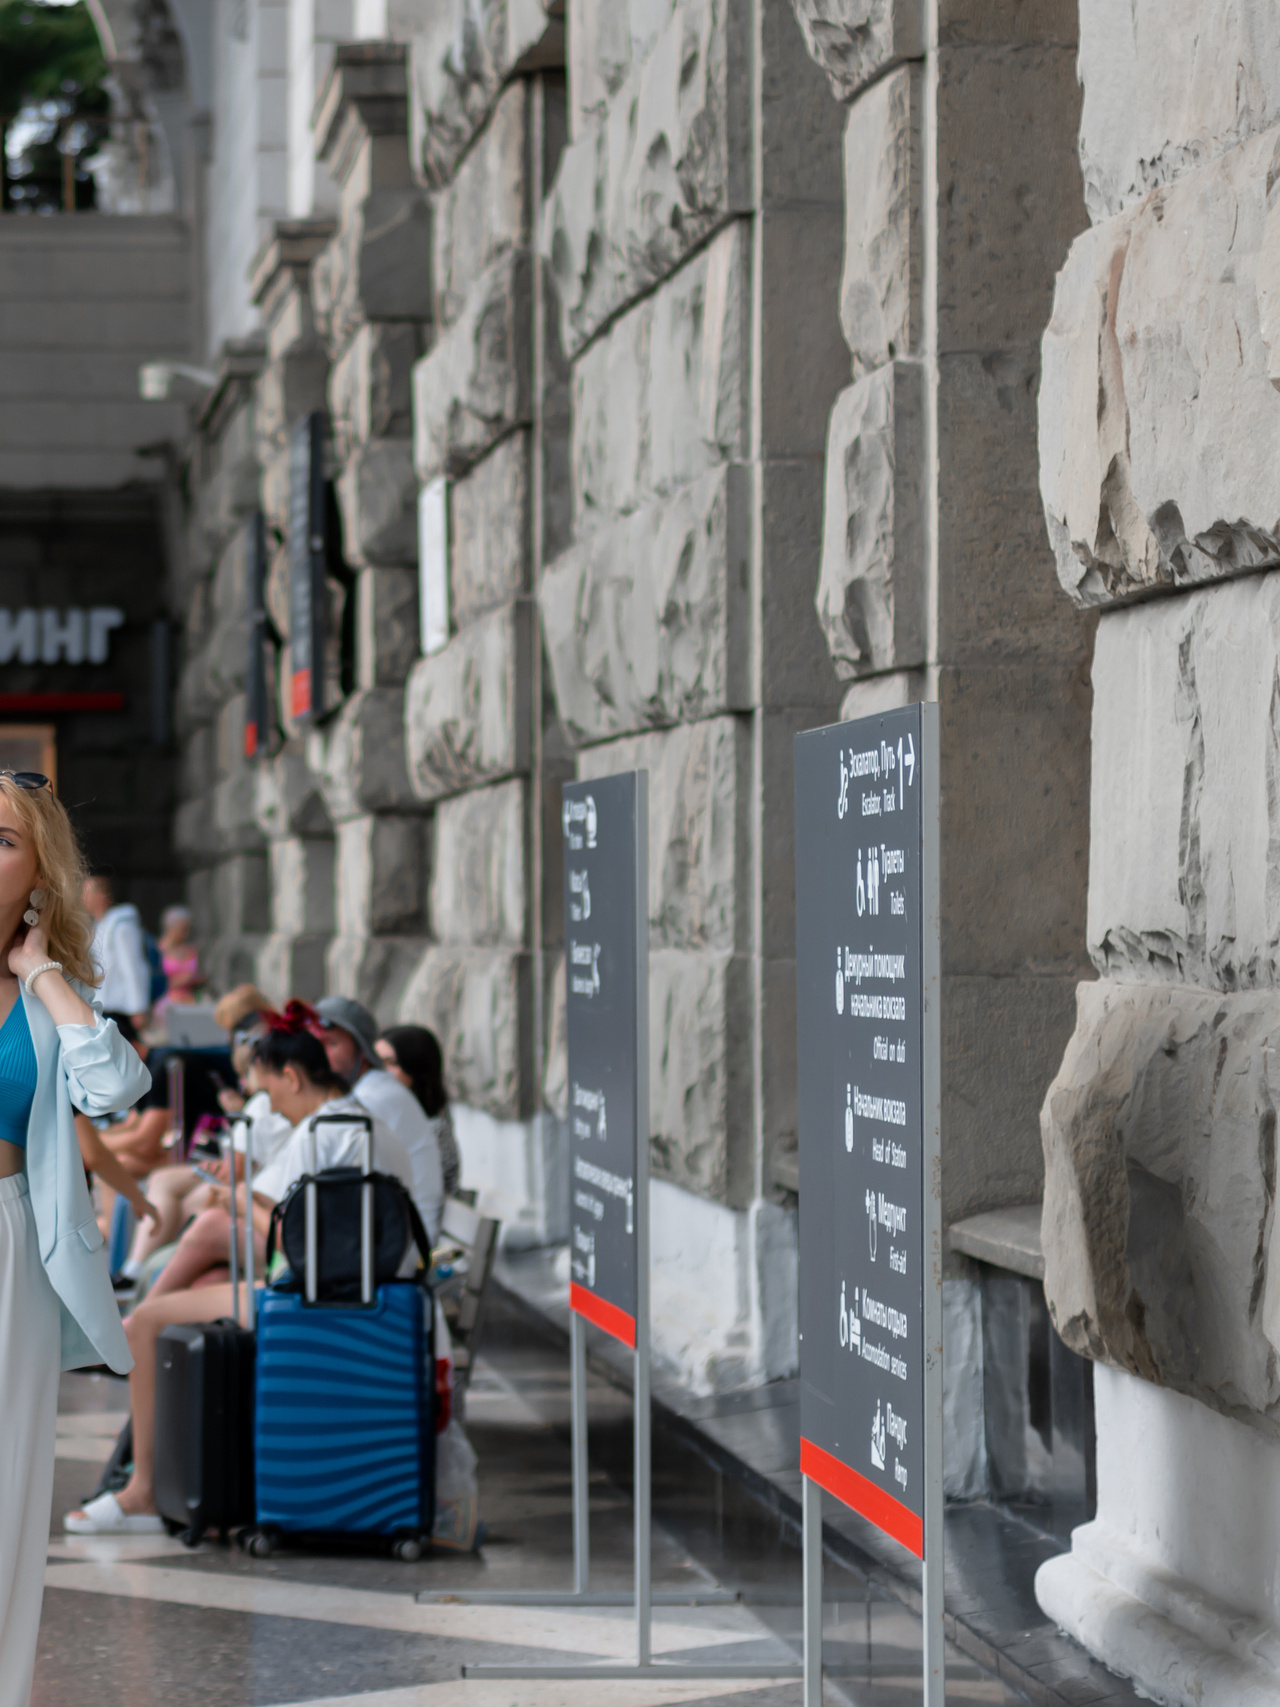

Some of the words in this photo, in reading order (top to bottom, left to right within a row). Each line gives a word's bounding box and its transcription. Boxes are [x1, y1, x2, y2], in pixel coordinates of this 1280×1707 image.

[881, 740, 895, 779] Путь
[883, 786, 895, 813] Track
[881, 844, 904, 883] Туалеты
[890, 890, 905, 915] Toilets
[845, 944, 873, 985] Дежурный
[874, 953, 905, 984] помощник
[851, 994, 882, 1019] начальника
[883, 996, 906, 1020] вокзала
[873, 1035, 888, 1061] Official
[889, 1043, 896, 1062] on
[853, 1085, 883, 1121] Начальник
[884, 1098, 906, 1126] вокзала
[872, 1137, 884, 1163] Head
[885, 1139, 891, 1164] of
[891, 1141, 907, 1169] Station
[878, 1192, 907, 1238] Медпункт
[862, 1288, 887, 1328] Комнаты
[887, 1307, 907, 1339] отдыха
[891, 1354, 907, 1381] services
[886, 1402, 907, 1450] Пандус
